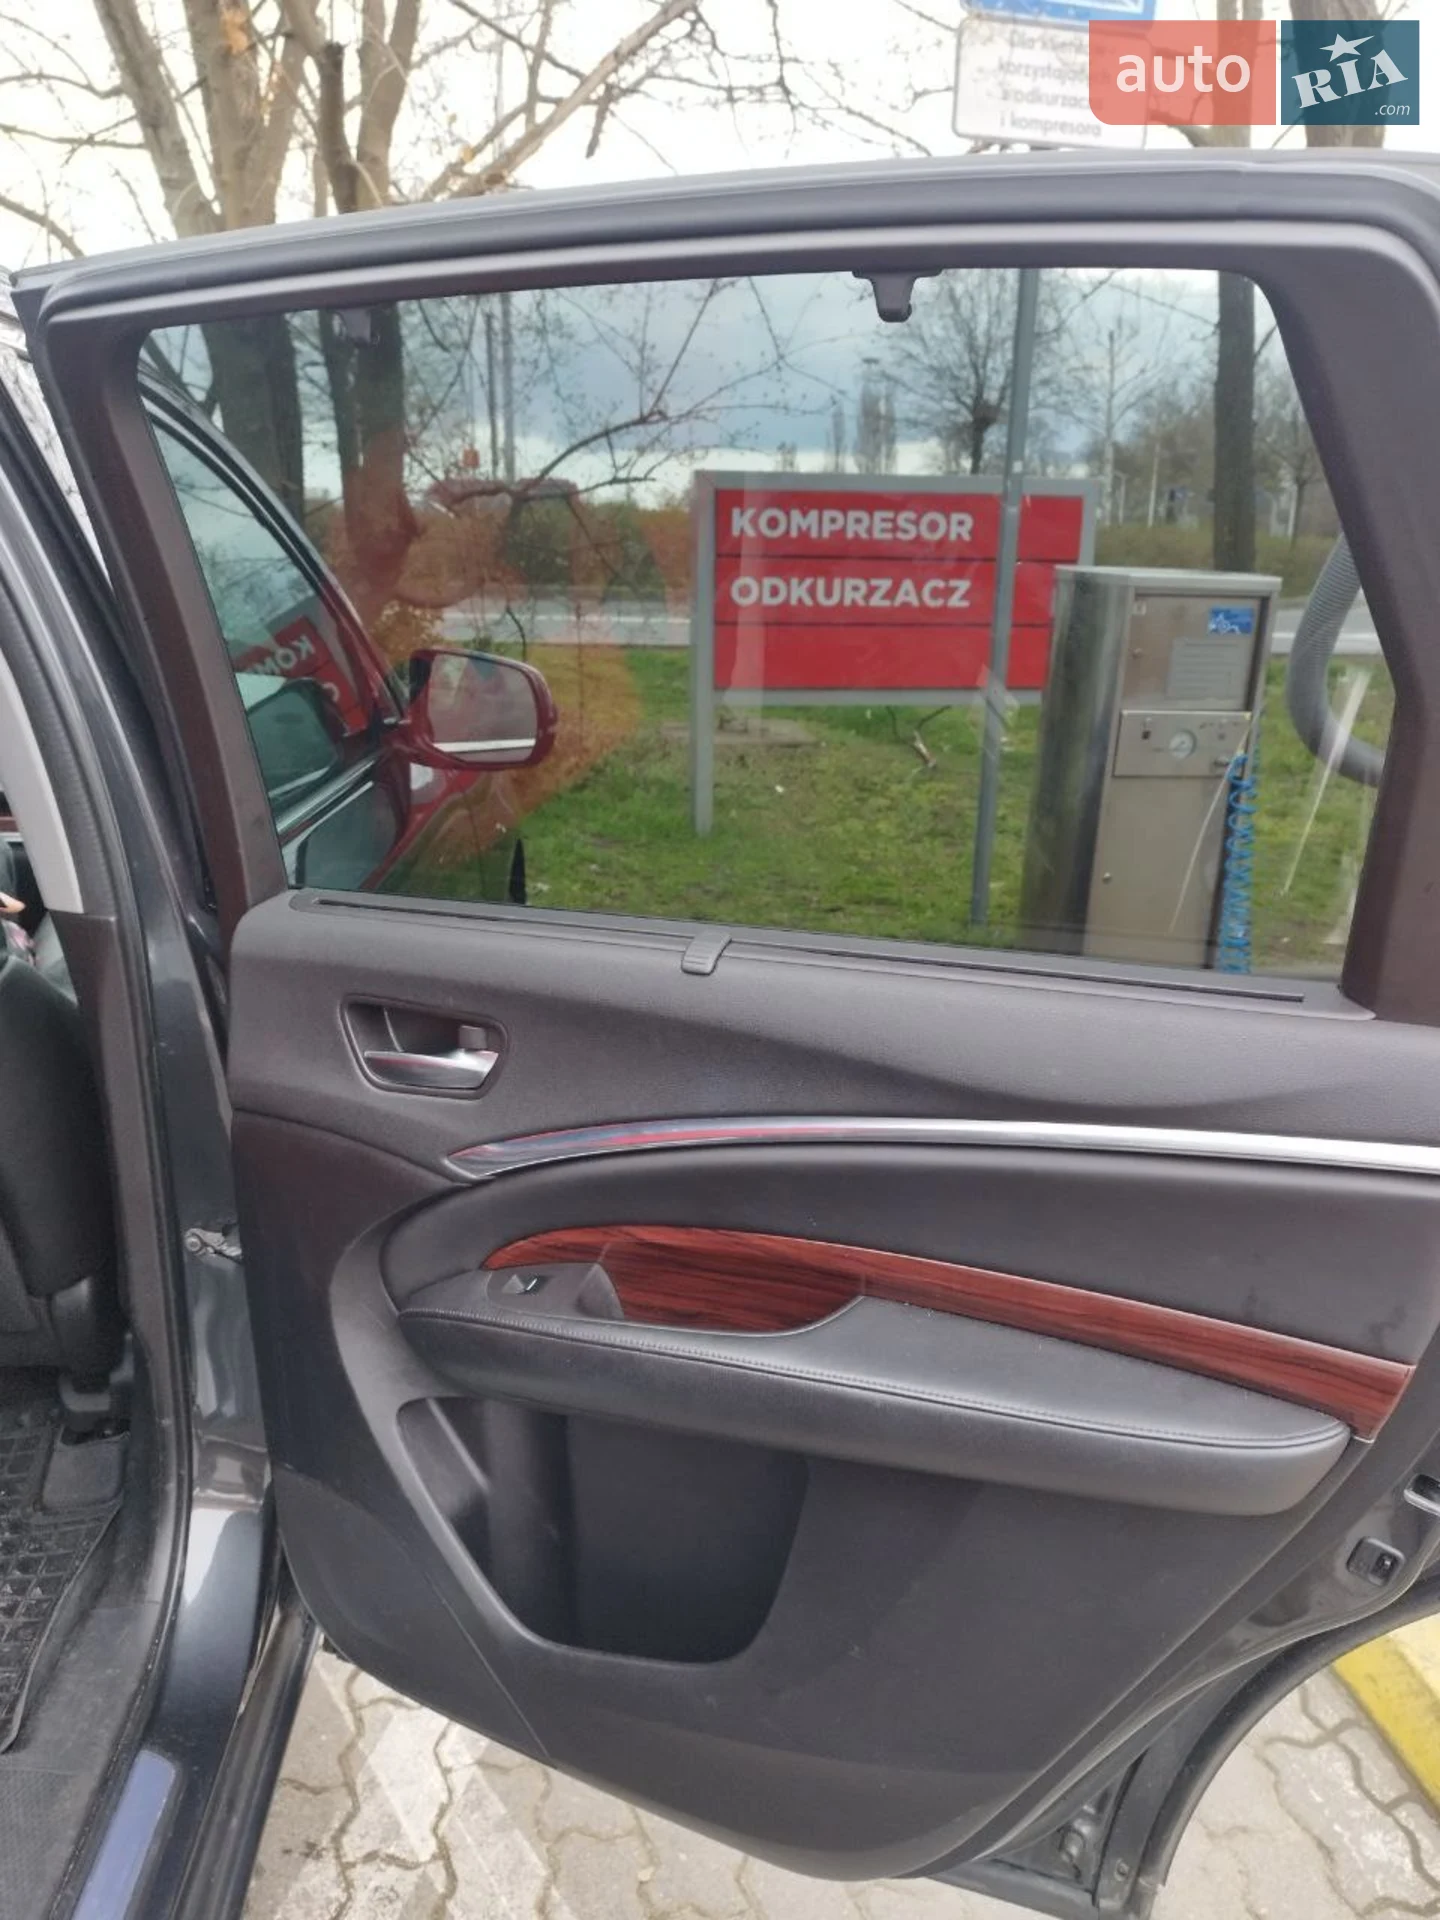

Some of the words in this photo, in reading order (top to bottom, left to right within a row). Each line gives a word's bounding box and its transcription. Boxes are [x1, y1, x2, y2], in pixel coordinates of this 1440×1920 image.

[1010, 110, 1102, 138] kompresora
[730, 507, 974, 542] KOMPRESOR
[730, 576, 972, 608] ODKURZACZ
